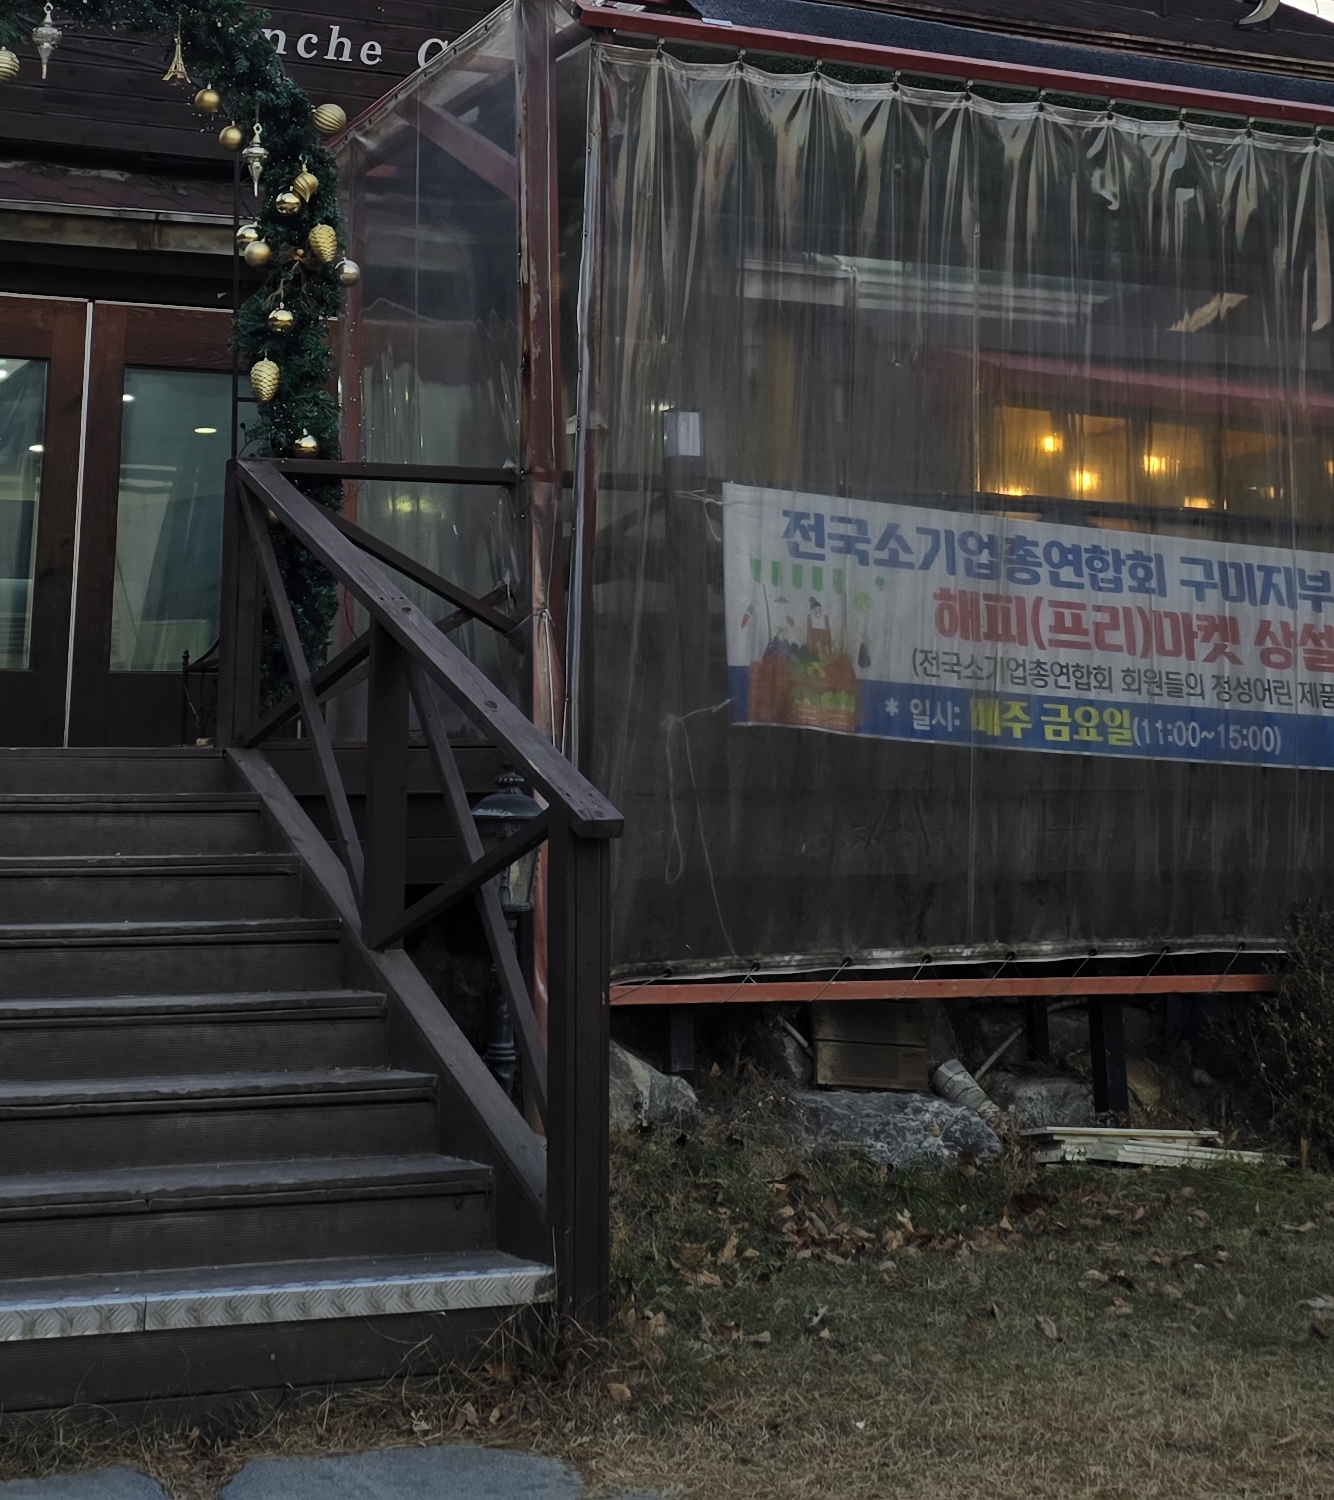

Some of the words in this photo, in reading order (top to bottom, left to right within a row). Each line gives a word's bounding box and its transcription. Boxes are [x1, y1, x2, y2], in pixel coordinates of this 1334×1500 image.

[261, 24, 383, 66] nche
[781, 508, 1167, 598] 전국소기업총연합회
[932, 586, 1245, 666] 해피(프리)마켓
[911, 647, 1114, 694] (전국소기업총연합회
[1120, 667, 1206, 701] 회원들의
[1211, 674, 1294, 707] 정성어린
[909, 697, 961, 732] 일시:
[969, 698, 1033, 739] 매주
